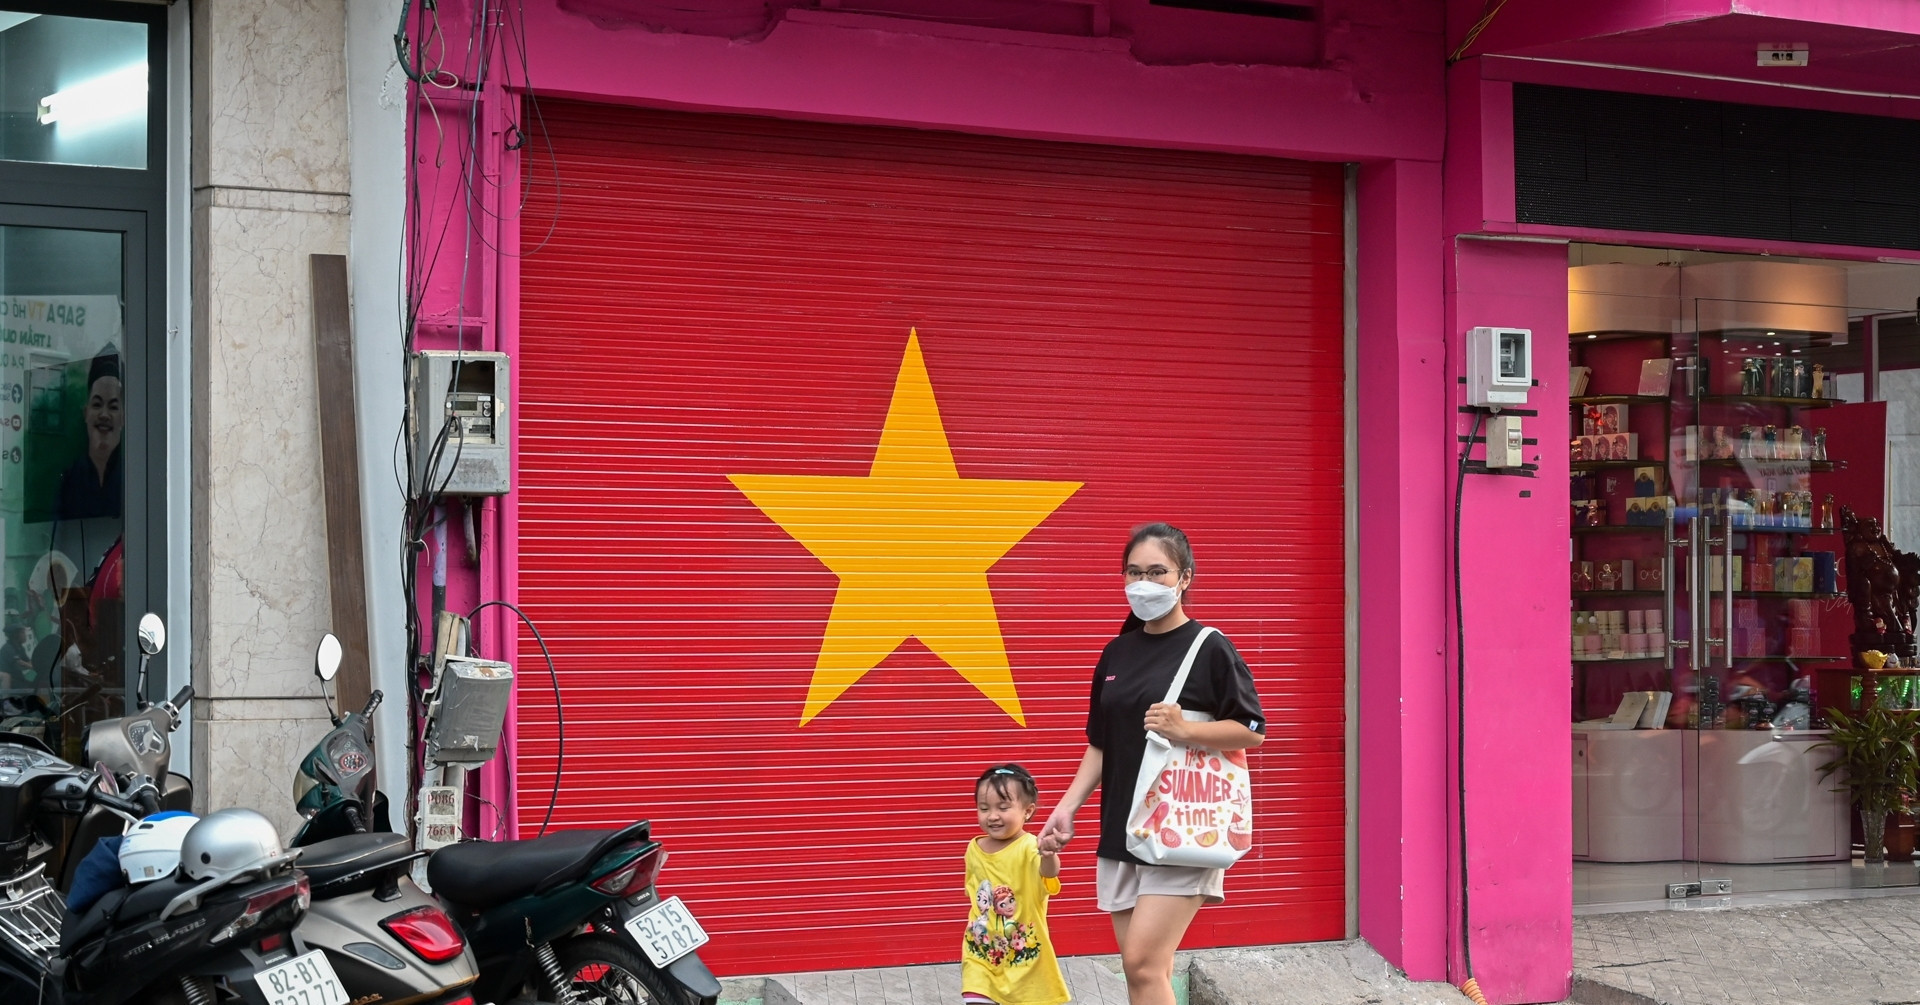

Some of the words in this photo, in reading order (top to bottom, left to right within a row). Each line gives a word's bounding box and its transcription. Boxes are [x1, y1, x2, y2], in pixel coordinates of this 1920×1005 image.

[1158, 769, 1231, 803] SUMMER
[651, 925, 699, 960] 5782
[268, 957, 322, 995] 82-B1
